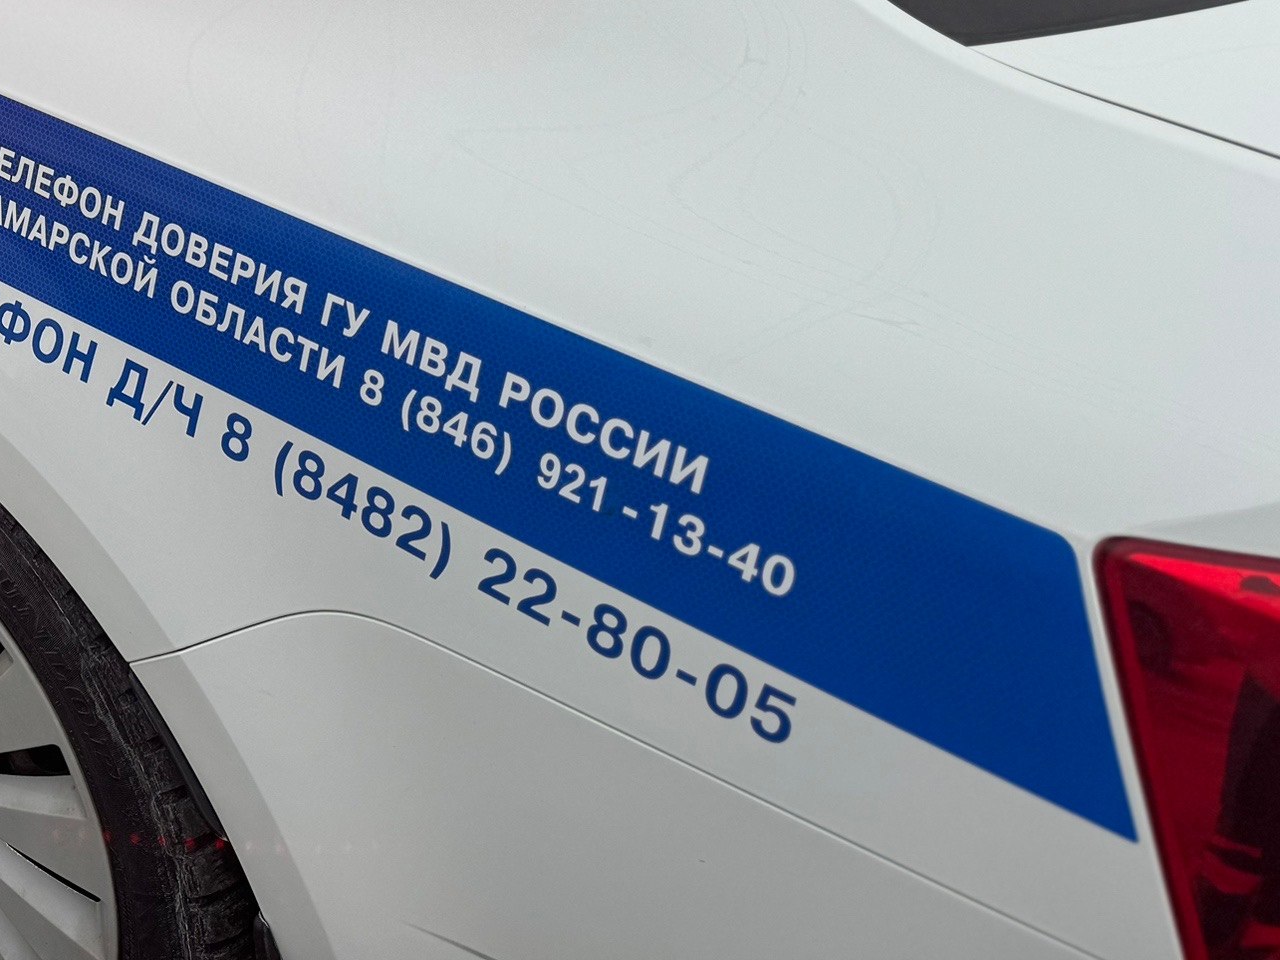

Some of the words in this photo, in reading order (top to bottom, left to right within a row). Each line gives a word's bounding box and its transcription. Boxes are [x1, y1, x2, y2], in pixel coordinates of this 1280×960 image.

[131, 211, 308, 315] ДОВЕРИЯ
[320, 292, 371, 338] ГУ
[380, 319, 482, 402] МВД
[498, 370, 710, 495] РОССИИ
[170, 280, 347, 389] ОБЛАСТИ
[359, 369, 385, 406] 8
[401, 388, 512, 476] (846)
[105, 357, 204, 438] Д/Ч
[221, 412, 253, 462] 8
[274, 439, 452, 580] (8482)
[477, 547, 798, 744] 22-80-05
